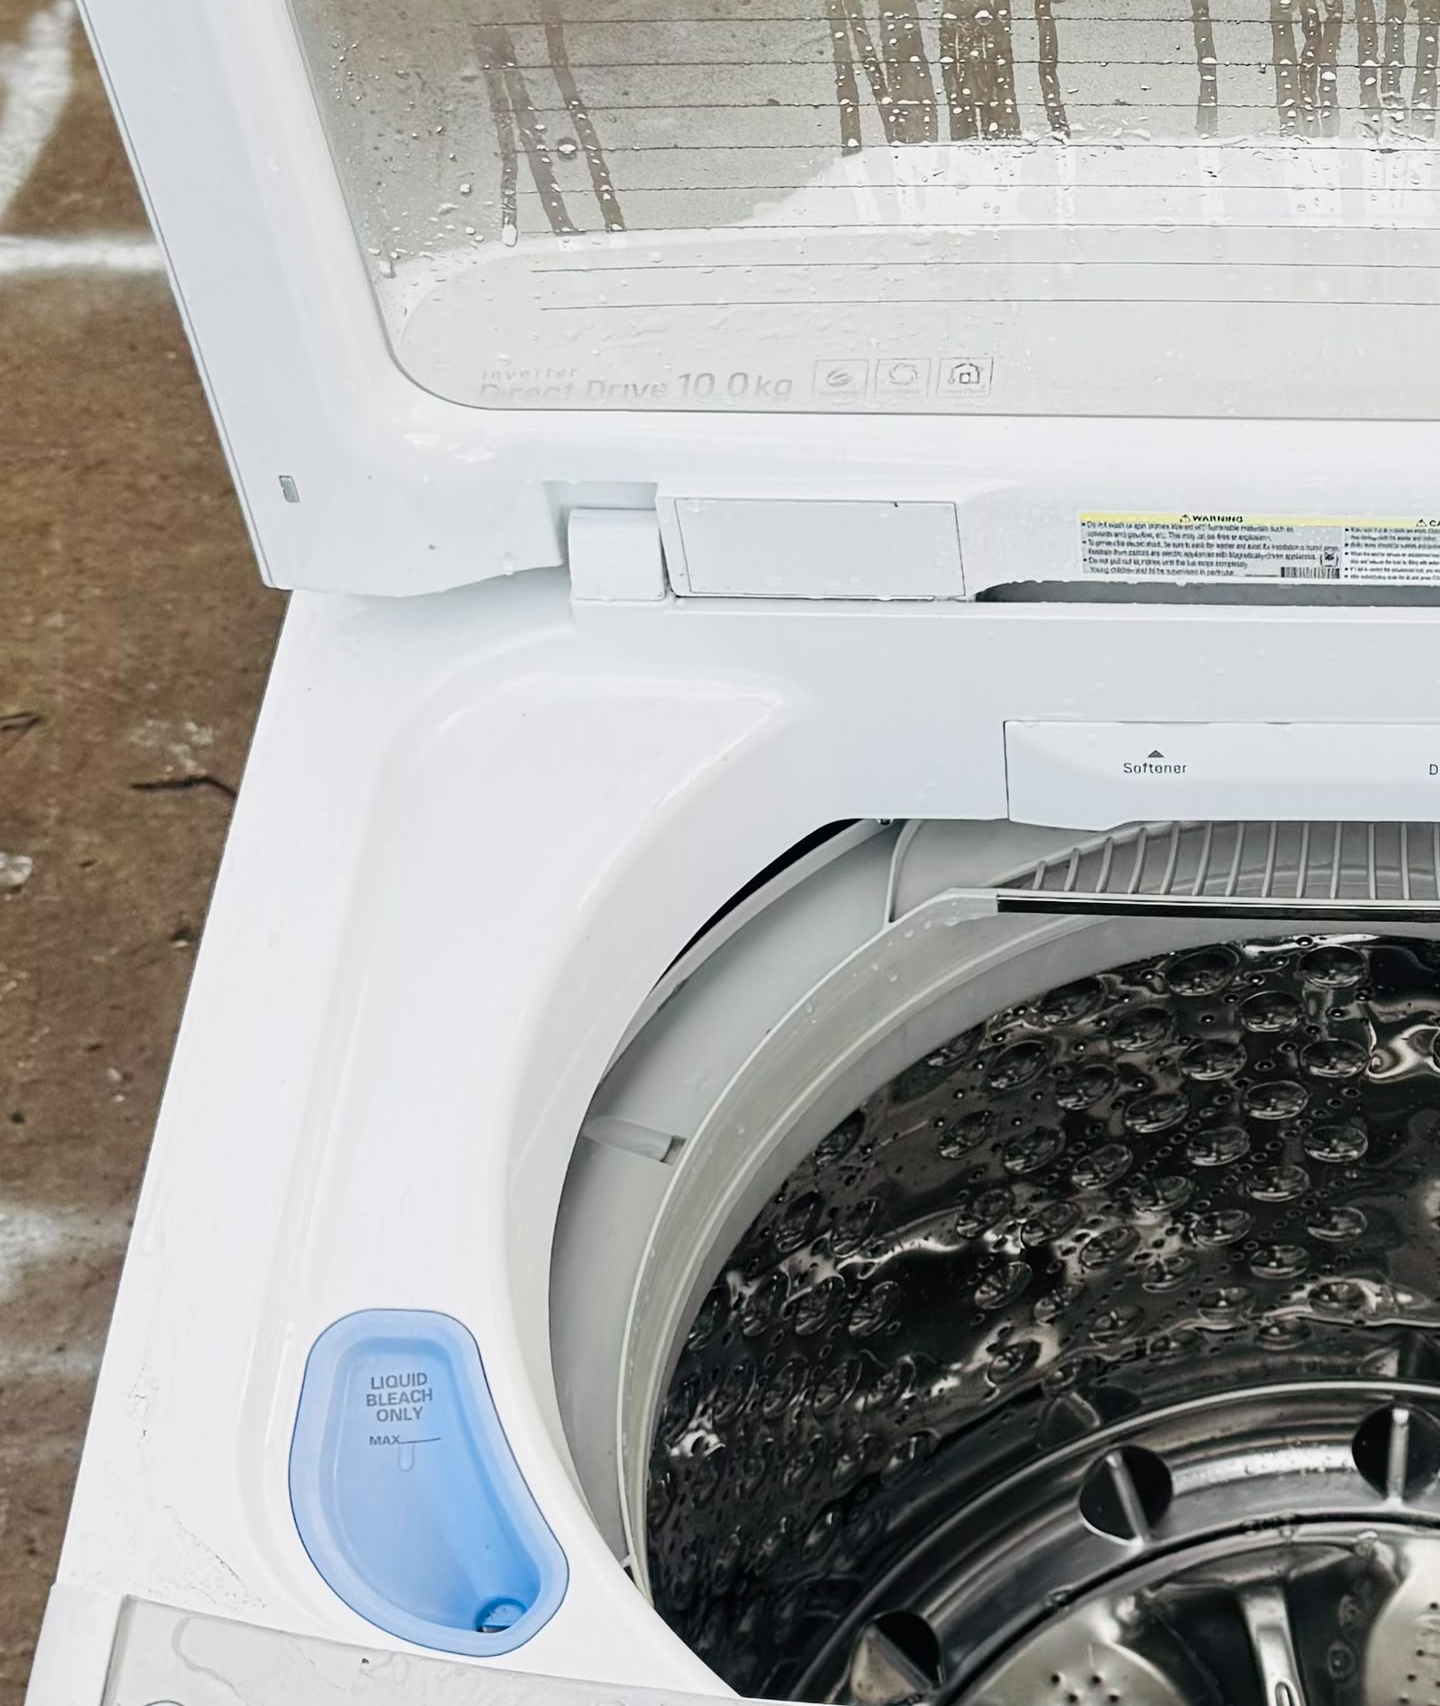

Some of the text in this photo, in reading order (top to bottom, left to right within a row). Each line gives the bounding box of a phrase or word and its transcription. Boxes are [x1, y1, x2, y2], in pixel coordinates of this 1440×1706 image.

[1192, 515, 1244, 523] WARNING
[1123, 762, 1188, 774] Softener
[371, 1372, 428, 1390] LIQUID
[366, 1389, 433, 1407] BLEACH
[376, 1406, 424, 1422] ONLY
